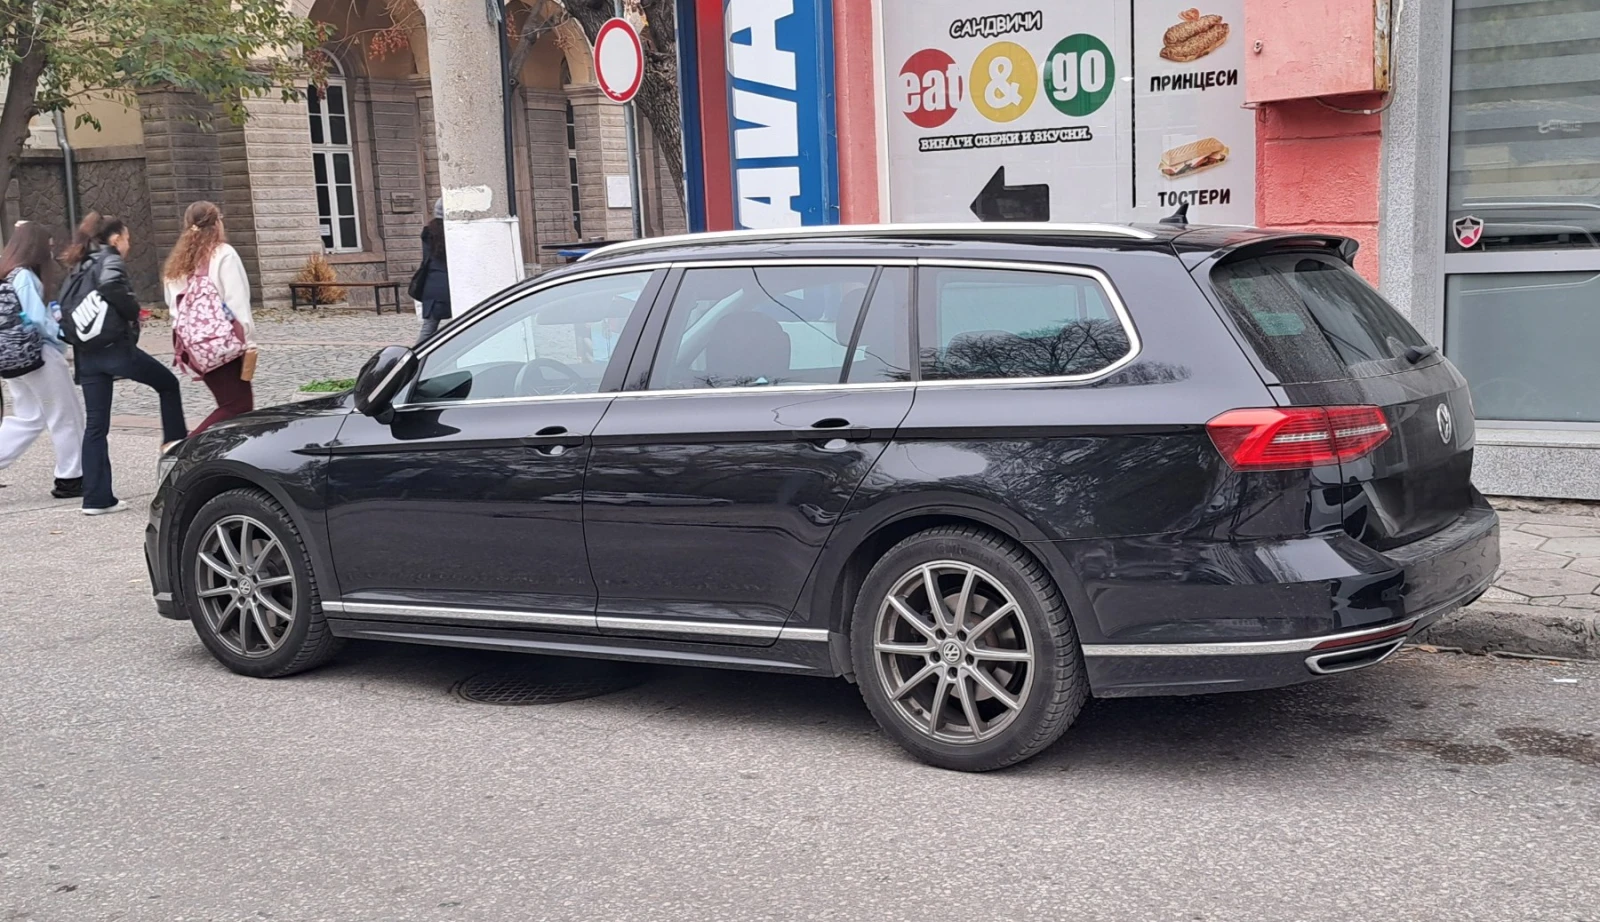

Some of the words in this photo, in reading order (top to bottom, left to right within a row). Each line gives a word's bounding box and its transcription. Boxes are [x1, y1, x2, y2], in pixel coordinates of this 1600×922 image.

[950, 11, 1042, 38] САНДВИЧИ
[899, 63, 964, 113] eat
[984, 56, 1023, 109] &
[1052, 49, 1106, 101] go
[1150, 69, 1238, 92] ПРИНЦЕСИ
[920, 136, 974, 150] ВИНАГИ
[974, 133, 1020, 147] СВЕЖИ
[1020, 131, 1032, 143] И
[1033, 127, 1092, 142] ВКУСНИ.
[1158, 188, 1231, 207] ТОСТЕРИ
[71, 289, 101, 332] NIKE
